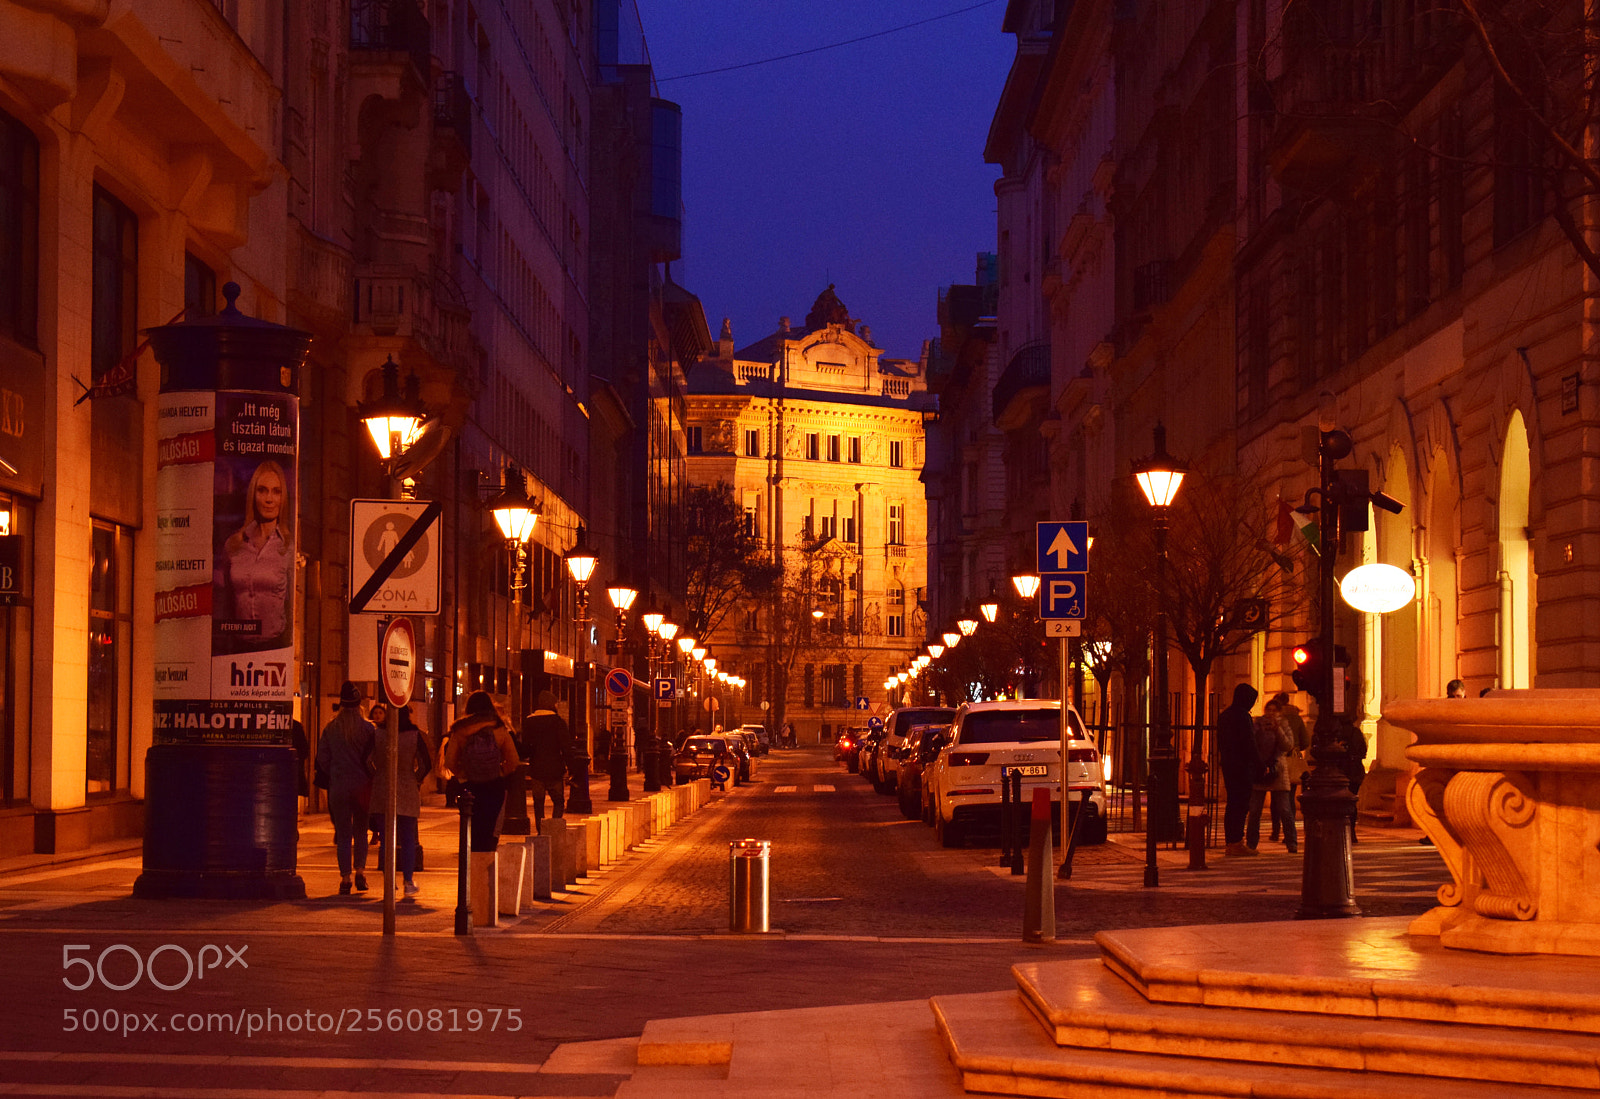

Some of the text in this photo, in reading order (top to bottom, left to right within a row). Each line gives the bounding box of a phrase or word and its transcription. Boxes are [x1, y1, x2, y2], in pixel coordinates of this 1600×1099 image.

[178, 406, 208, 418] HELYETT
[259, 404, 280, 421] még
[231, 420, 292, 437] tisztán látunk
[223, 439, 235, 451] és
[237, 439, 265, 455] igazat
[176, 559, 206, 570] HELYETT
[372, 586, 418, 602] ZÓNA
[1049, 580, 1077, 612] P
[1054, 623, 1062, 633] 2
[391, 669, 408, 680] CONTROL
[230, 688, 250, 697] valós
[251, 688, 270, 698] képet
[659, 681, 671, 697] P
[233, 701, 262, 709] ÁPRILIS
[175, 713, 251, 729] HALOTT
